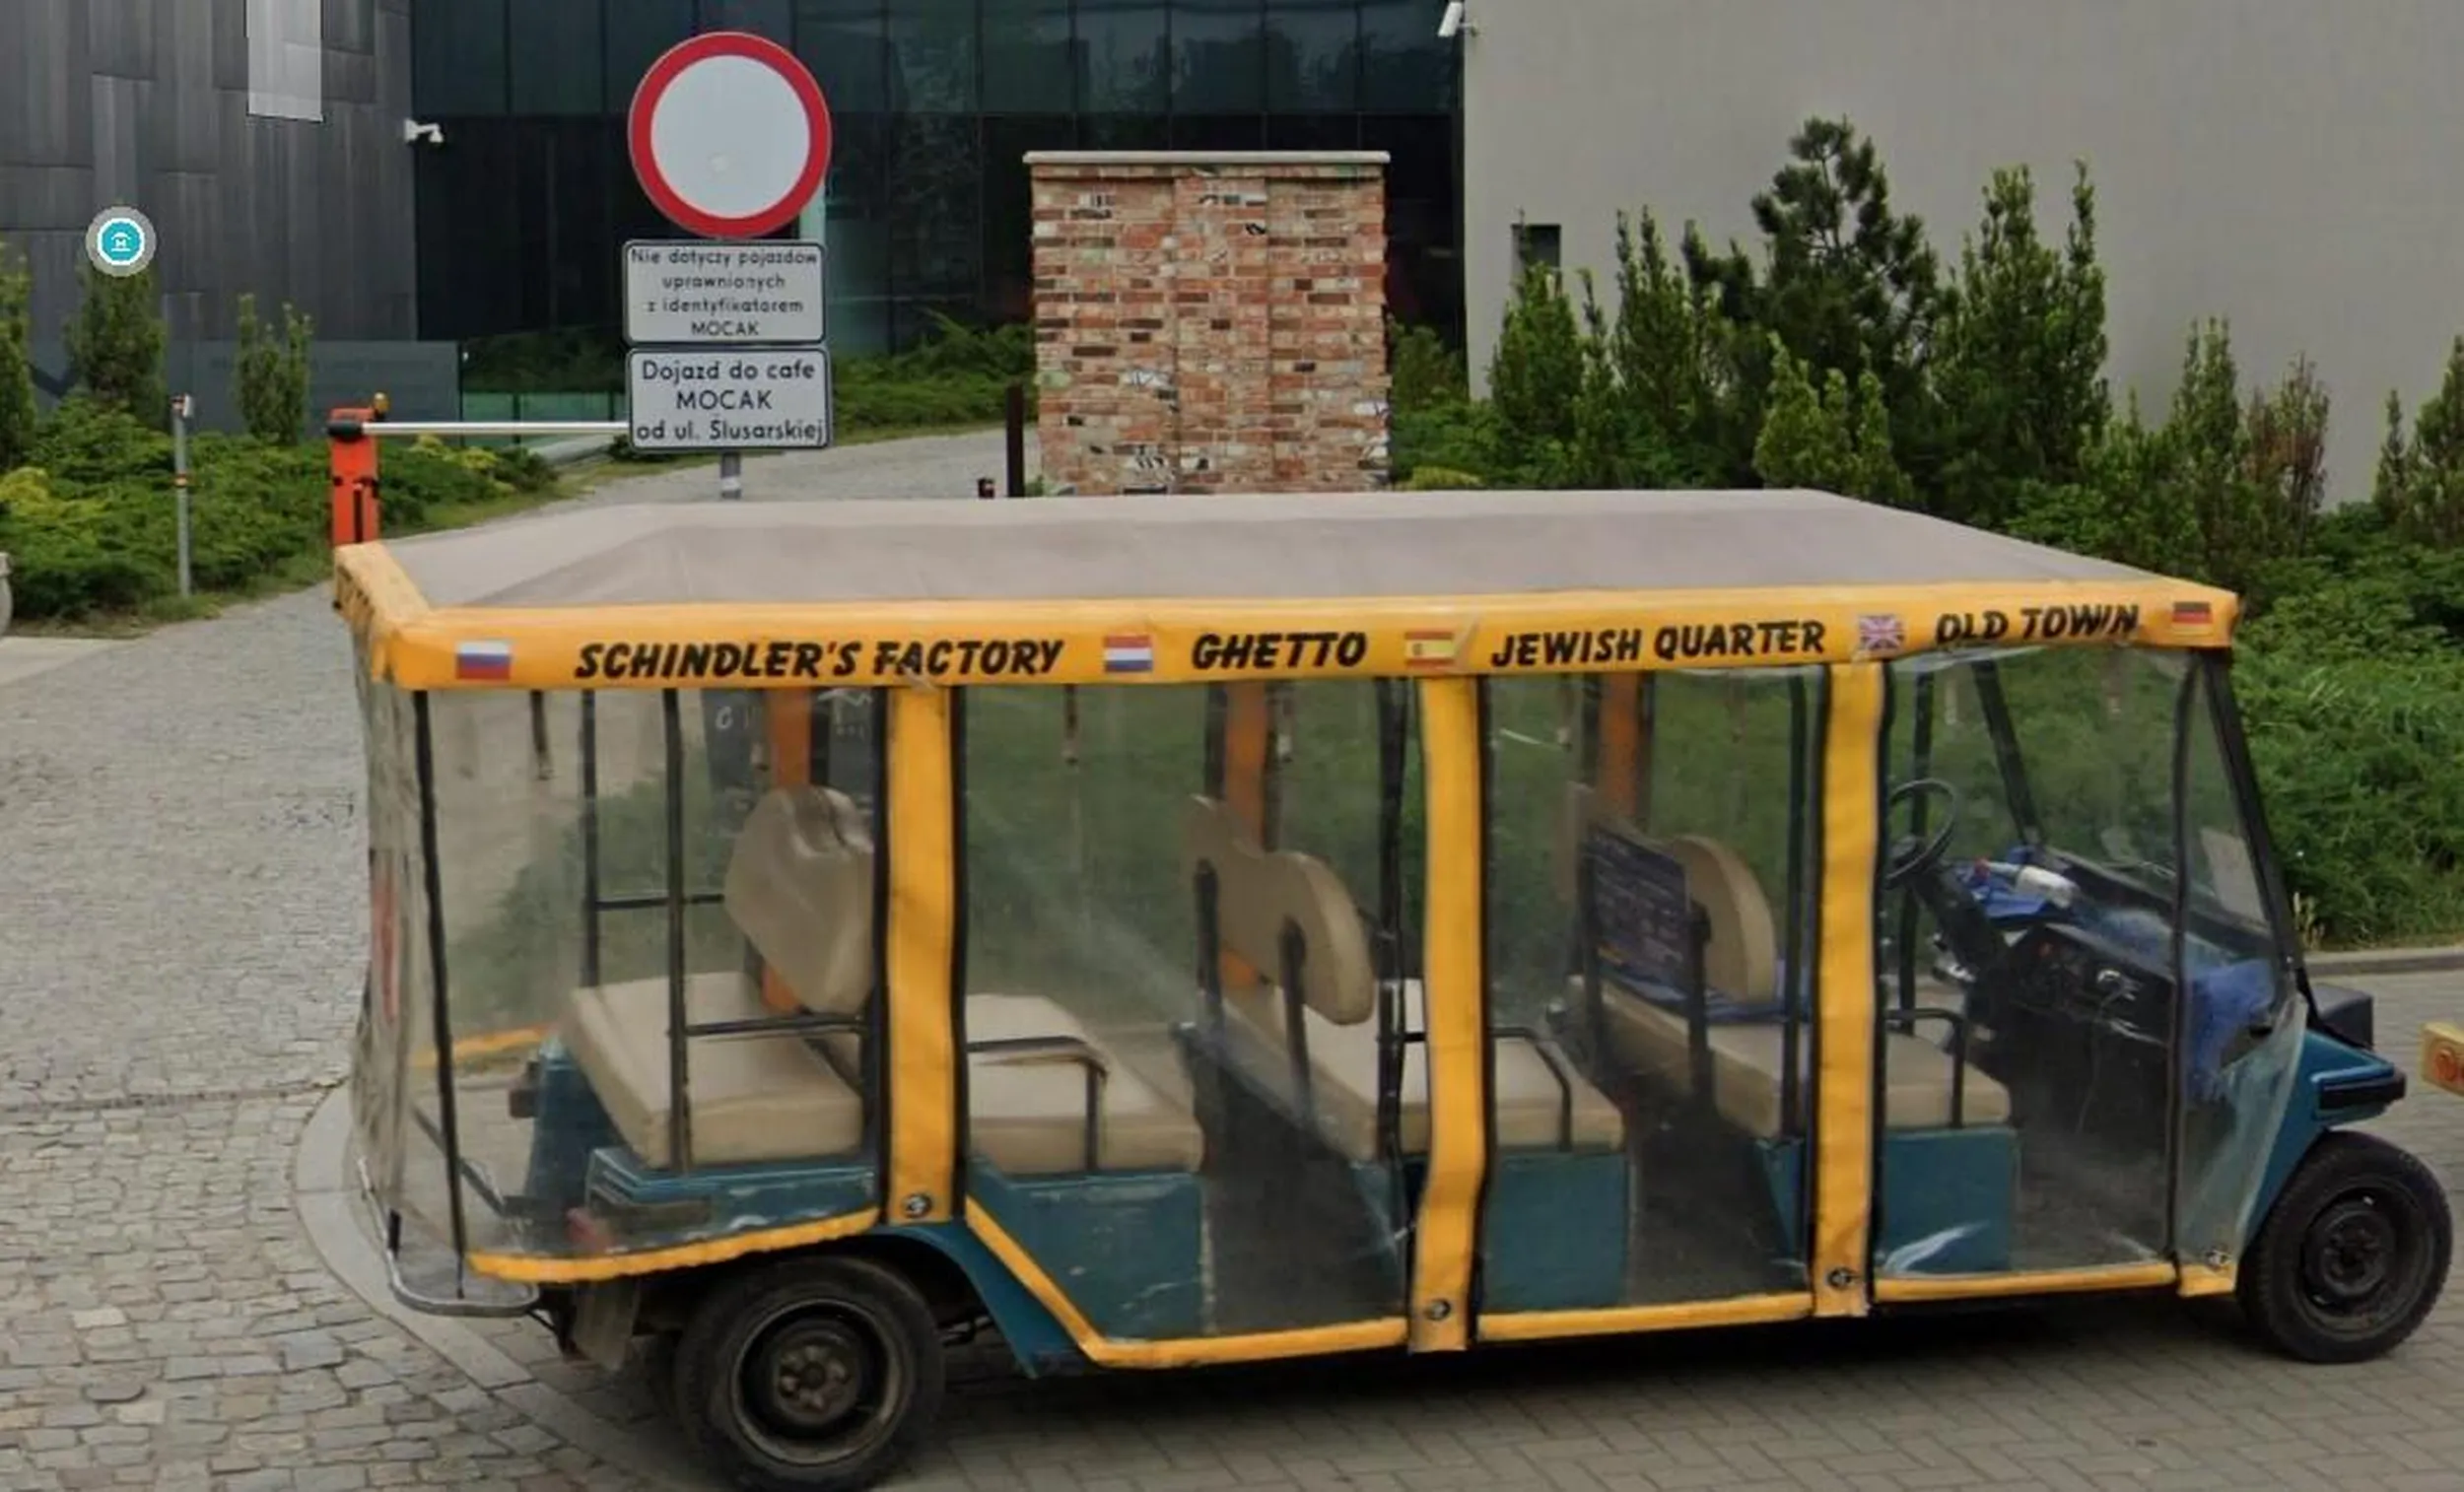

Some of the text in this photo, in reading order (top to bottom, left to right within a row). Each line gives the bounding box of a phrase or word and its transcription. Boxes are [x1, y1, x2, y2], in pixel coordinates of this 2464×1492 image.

[632, 247, 660, 264] Nie
[668, 248, 730, 269] dotyczy
[661, 273, 786, 293] uprawnionych
[647, 297, 804, 315] z identyfikatorem
[691, 321, 760, 336] MOCAK
[643, 360, 816, 384] Dojazd do cafe
[676, 390, 773, 411] MOCAK
[637, 413, 824, 443] od ul. Ślusarskiej
[1935, 612, 2009, 643] OLD
[1191, 632, 1368, 670] GHETTO
[1491, 620, 1826, 667] JEWISH QUARTER
[574, 639, 1064, 679] SCHINDLER'S FACTORY
